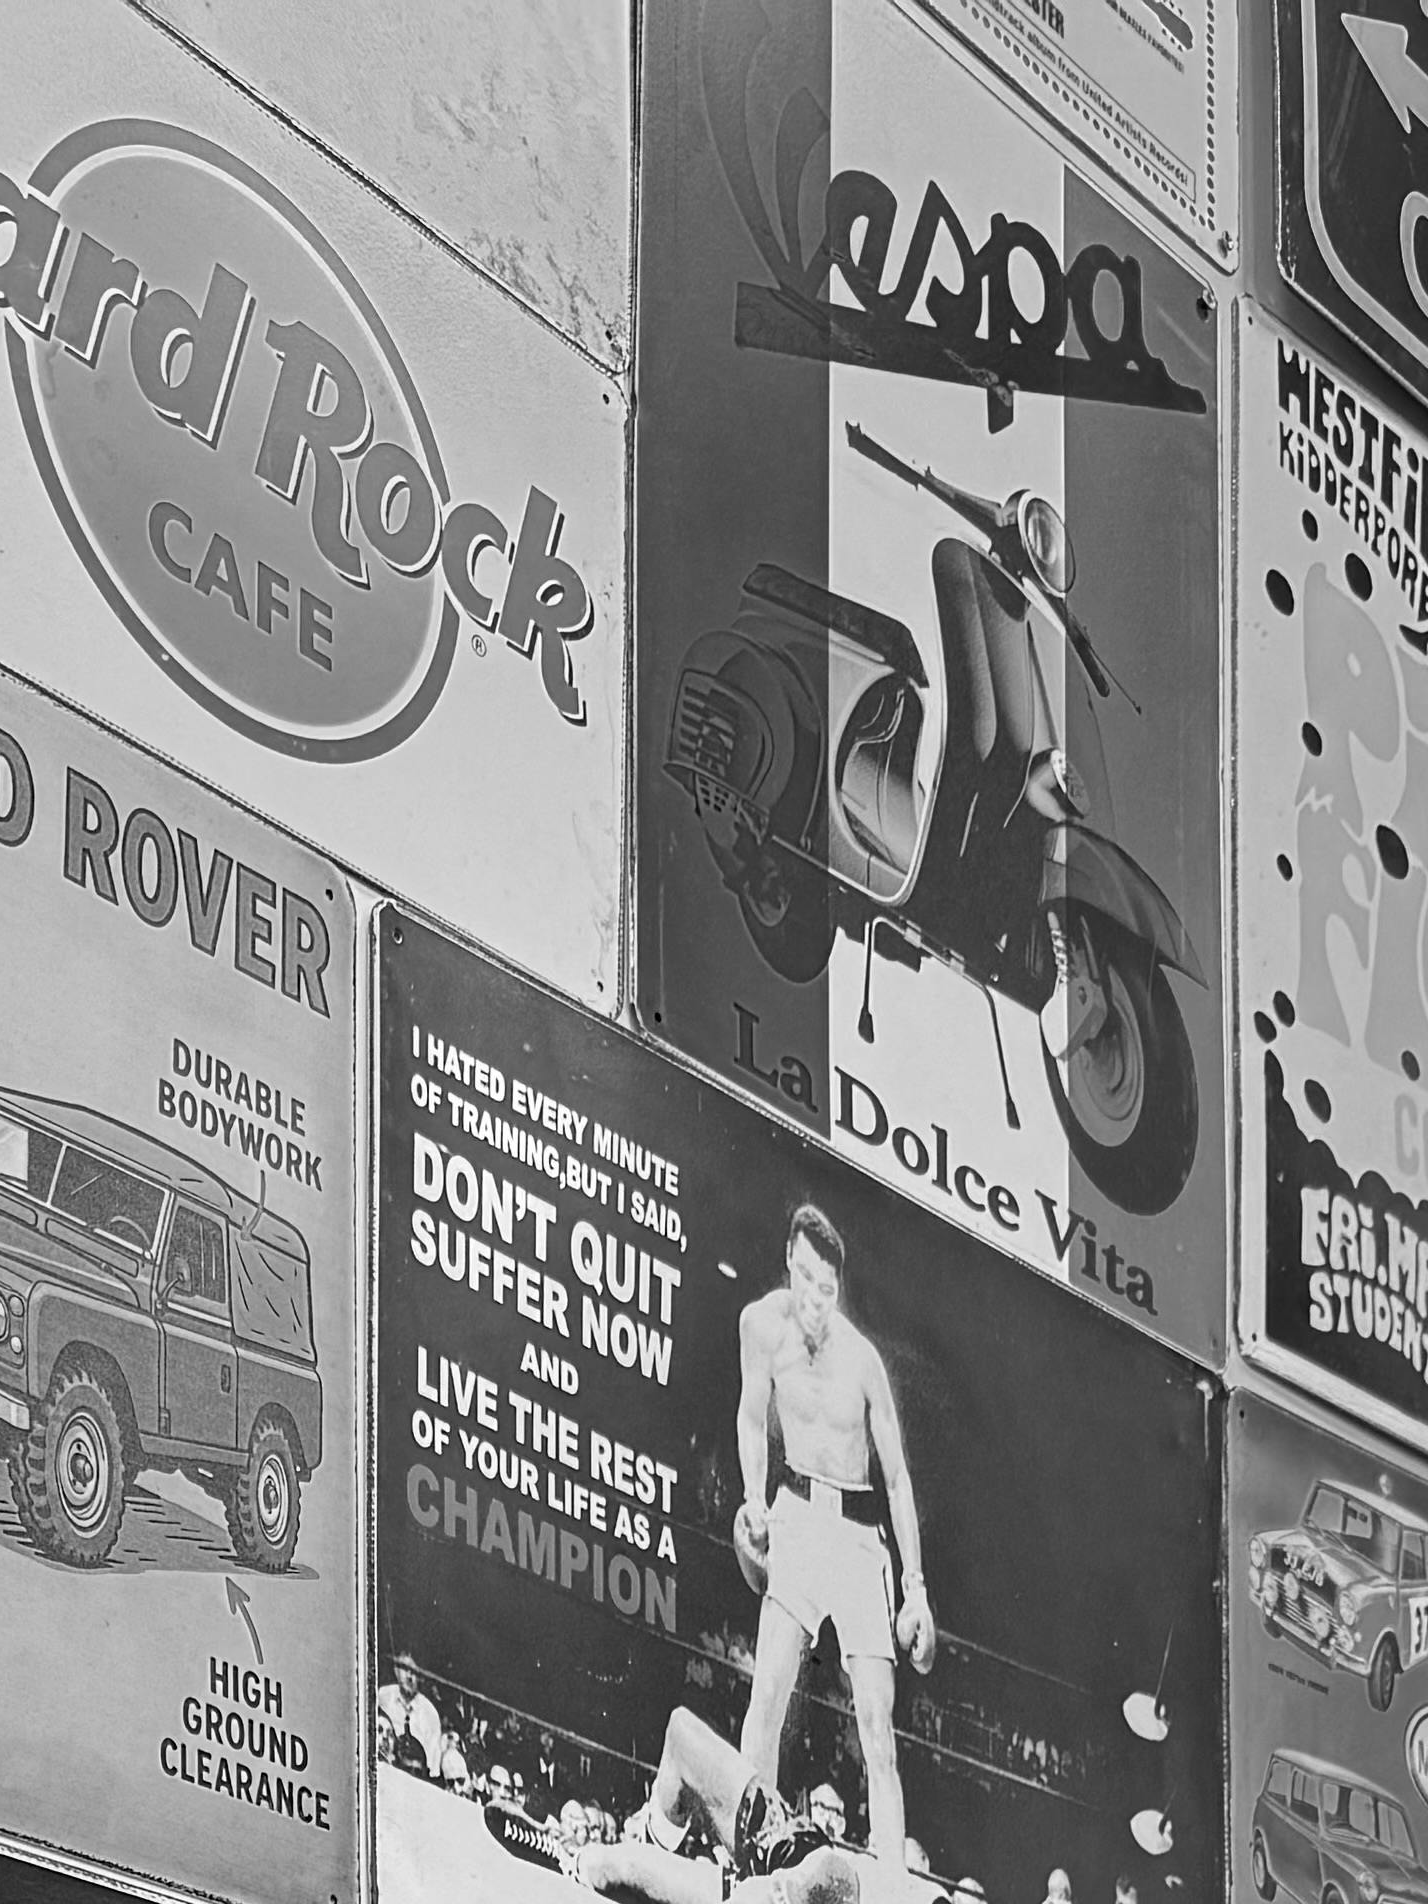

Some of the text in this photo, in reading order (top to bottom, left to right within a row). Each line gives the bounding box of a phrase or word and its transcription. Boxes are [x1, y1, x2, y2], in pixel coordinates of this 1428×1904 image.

[147, 501, 337, 674] CAFE
[255, 318, 594, 727] Rock
[63, 767, 332, 1019] ROVER
[158, 1077, 325, 1193] BODYWORK
[172, 1038, 308, 1138] DURABLE
[733, 1002, 1158, 1317] La Dolce Vita
[410, 1210, 673, 1386] SUFFER NOW
[571, 1219, 681, 1326] QUIT
[407, 1462, 678, 1634] CHAMPION
